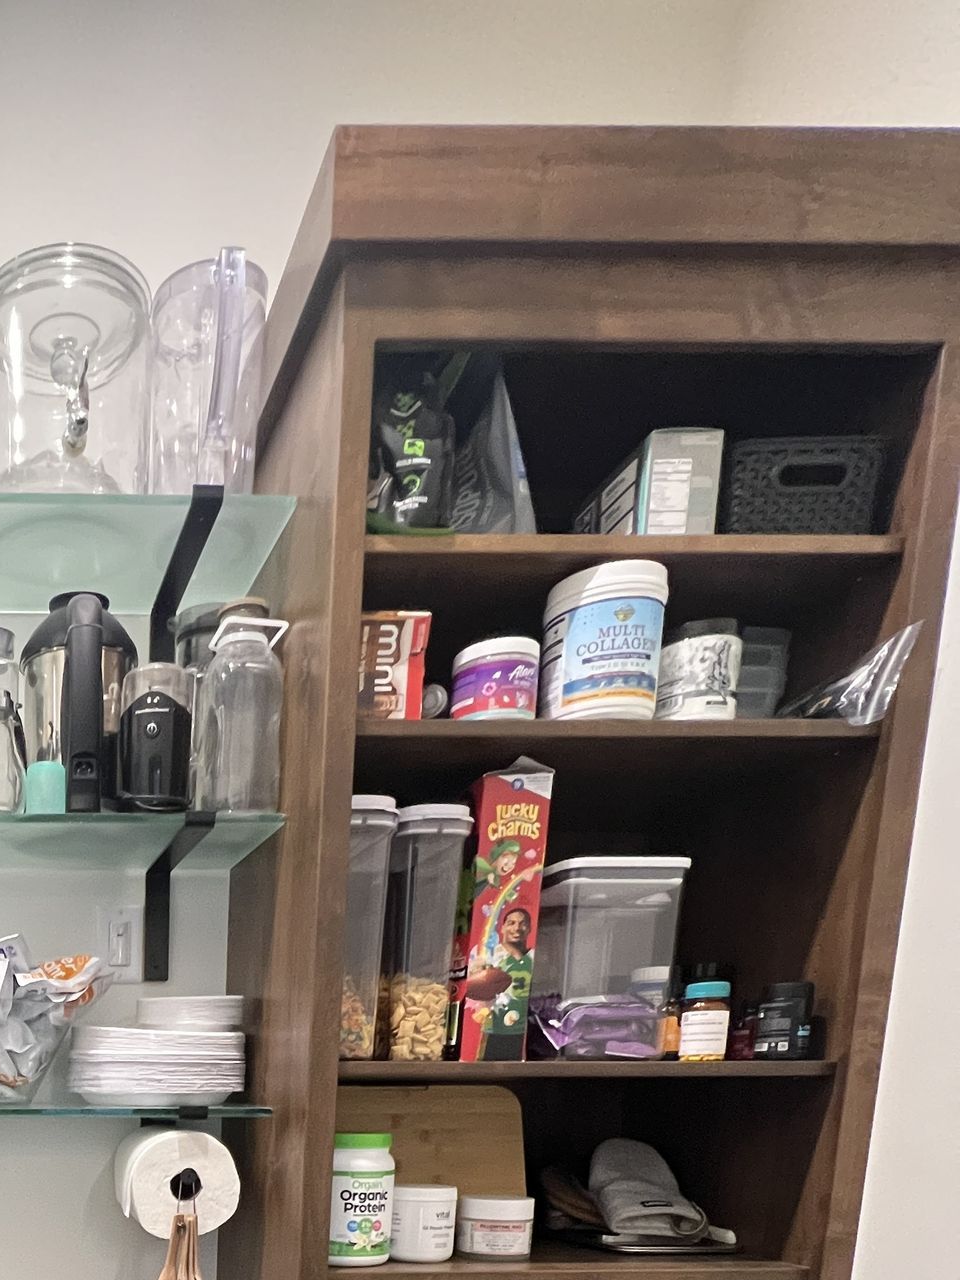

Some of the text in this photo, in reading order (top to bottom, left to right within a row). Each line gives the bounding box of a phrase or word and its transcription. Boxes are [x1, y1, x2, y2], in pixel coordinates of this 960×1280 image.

[598, 625, 646, 639] MULTI
[576, 637, 657, 656] COLLAGEN
[488, 820, 541, 842] Charms
[352, 1180, 383, 1190] Orgain
[340, 1190, 388, 1203] Organic
[344, 1201, 385, 1213] Protein
